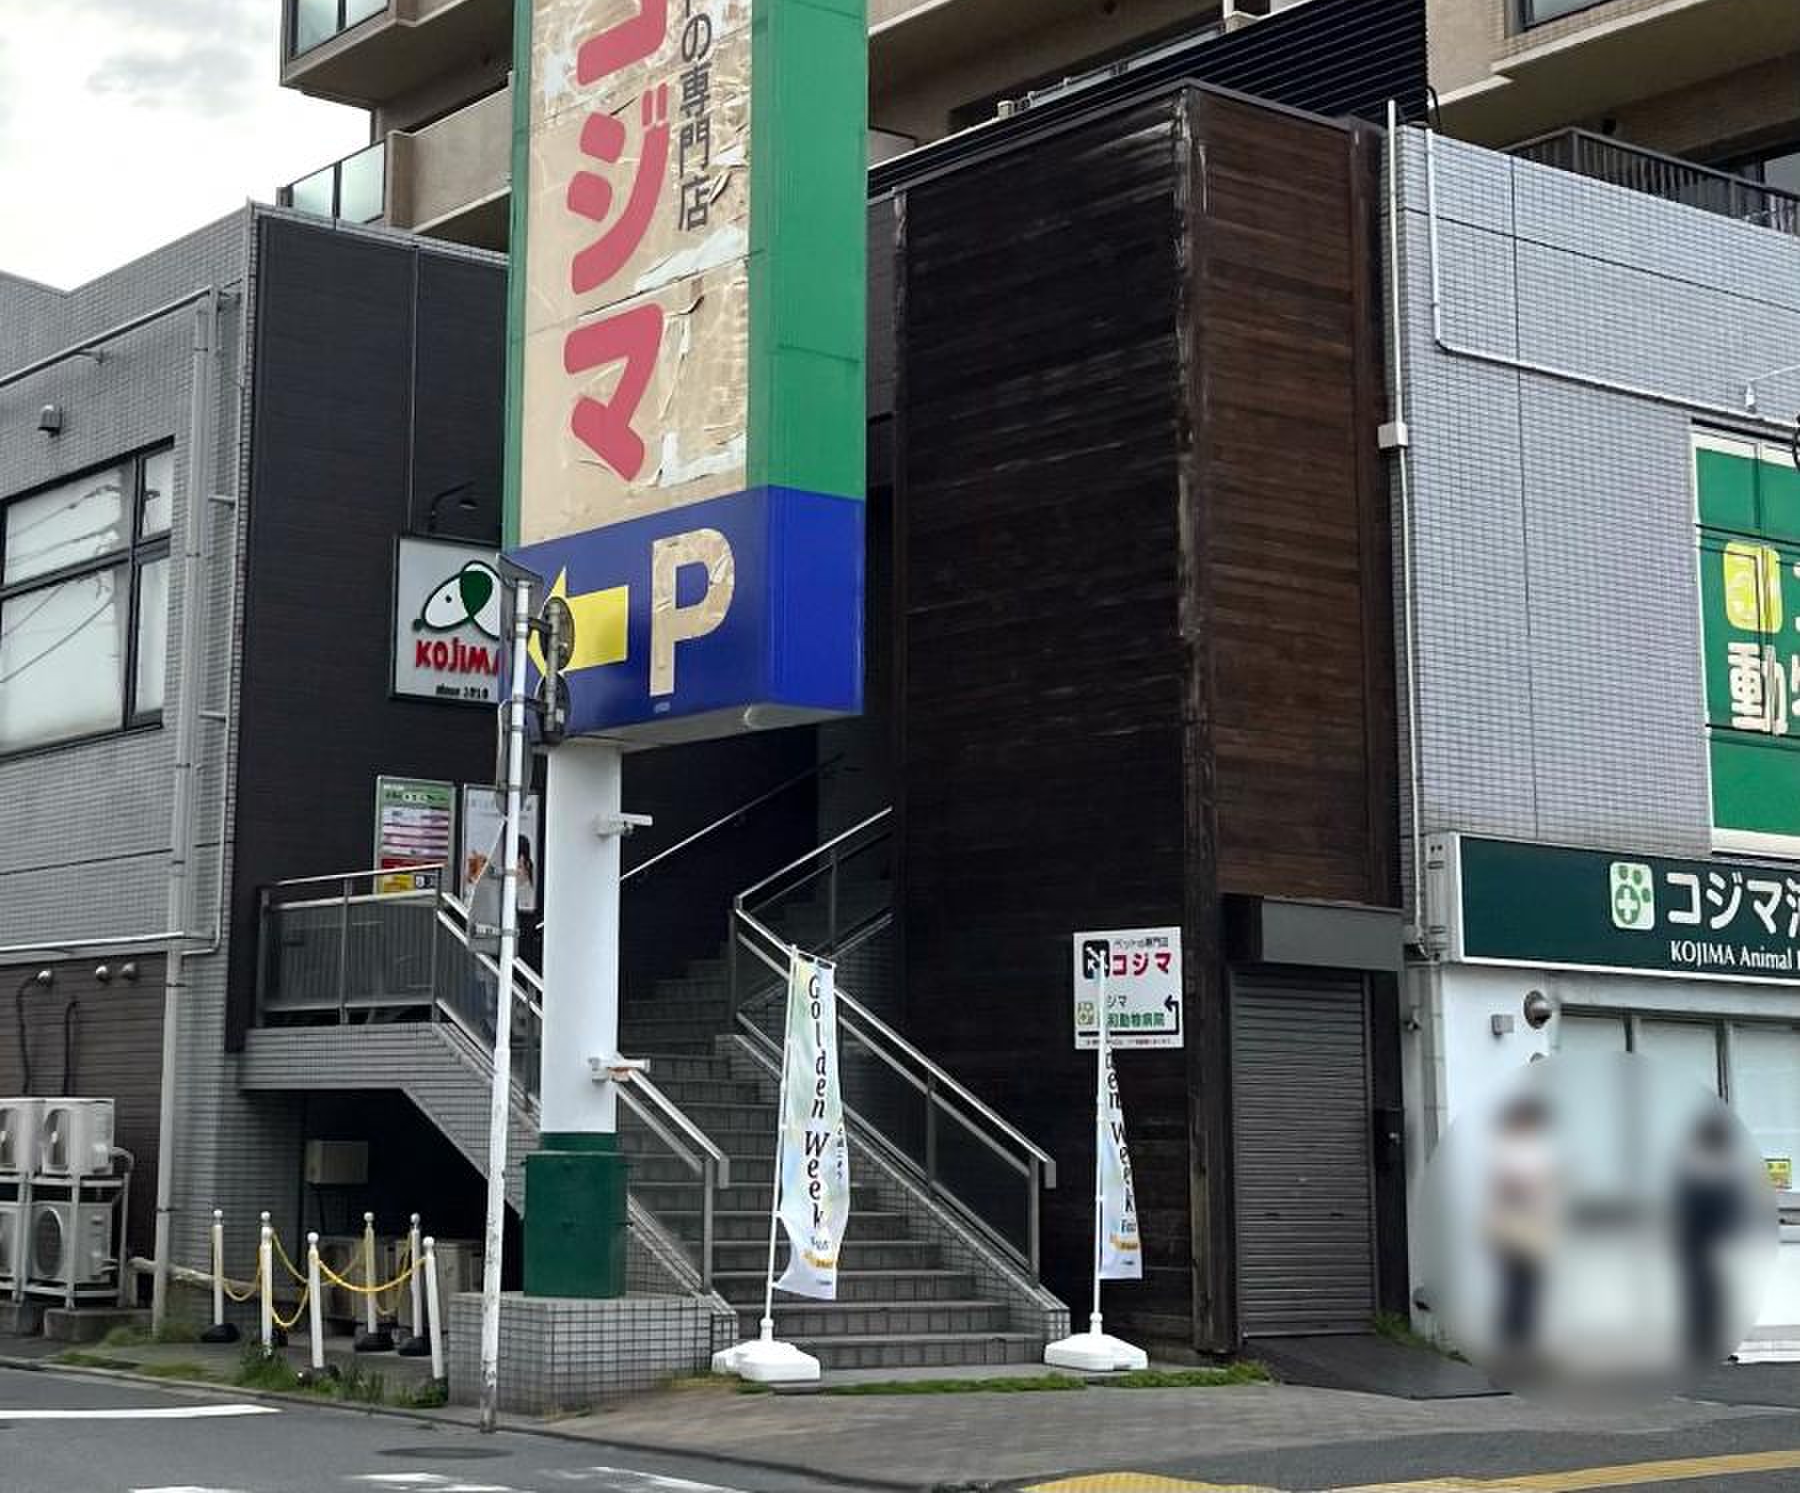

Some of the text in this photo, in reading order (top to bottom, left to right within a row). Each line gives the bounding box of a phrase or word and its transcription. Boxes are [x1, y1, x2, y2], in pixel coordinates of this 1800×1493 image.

[649, 527, 736, 697] P
[1112, 952, 1172, 976] コジマ
[1671, 940, 1735, 967] KOJIMA
[1740, 945, 1792, 969] Animal
[808, 974, 828, 1119] Golden
[805, 1130, 831, 1228] Week
